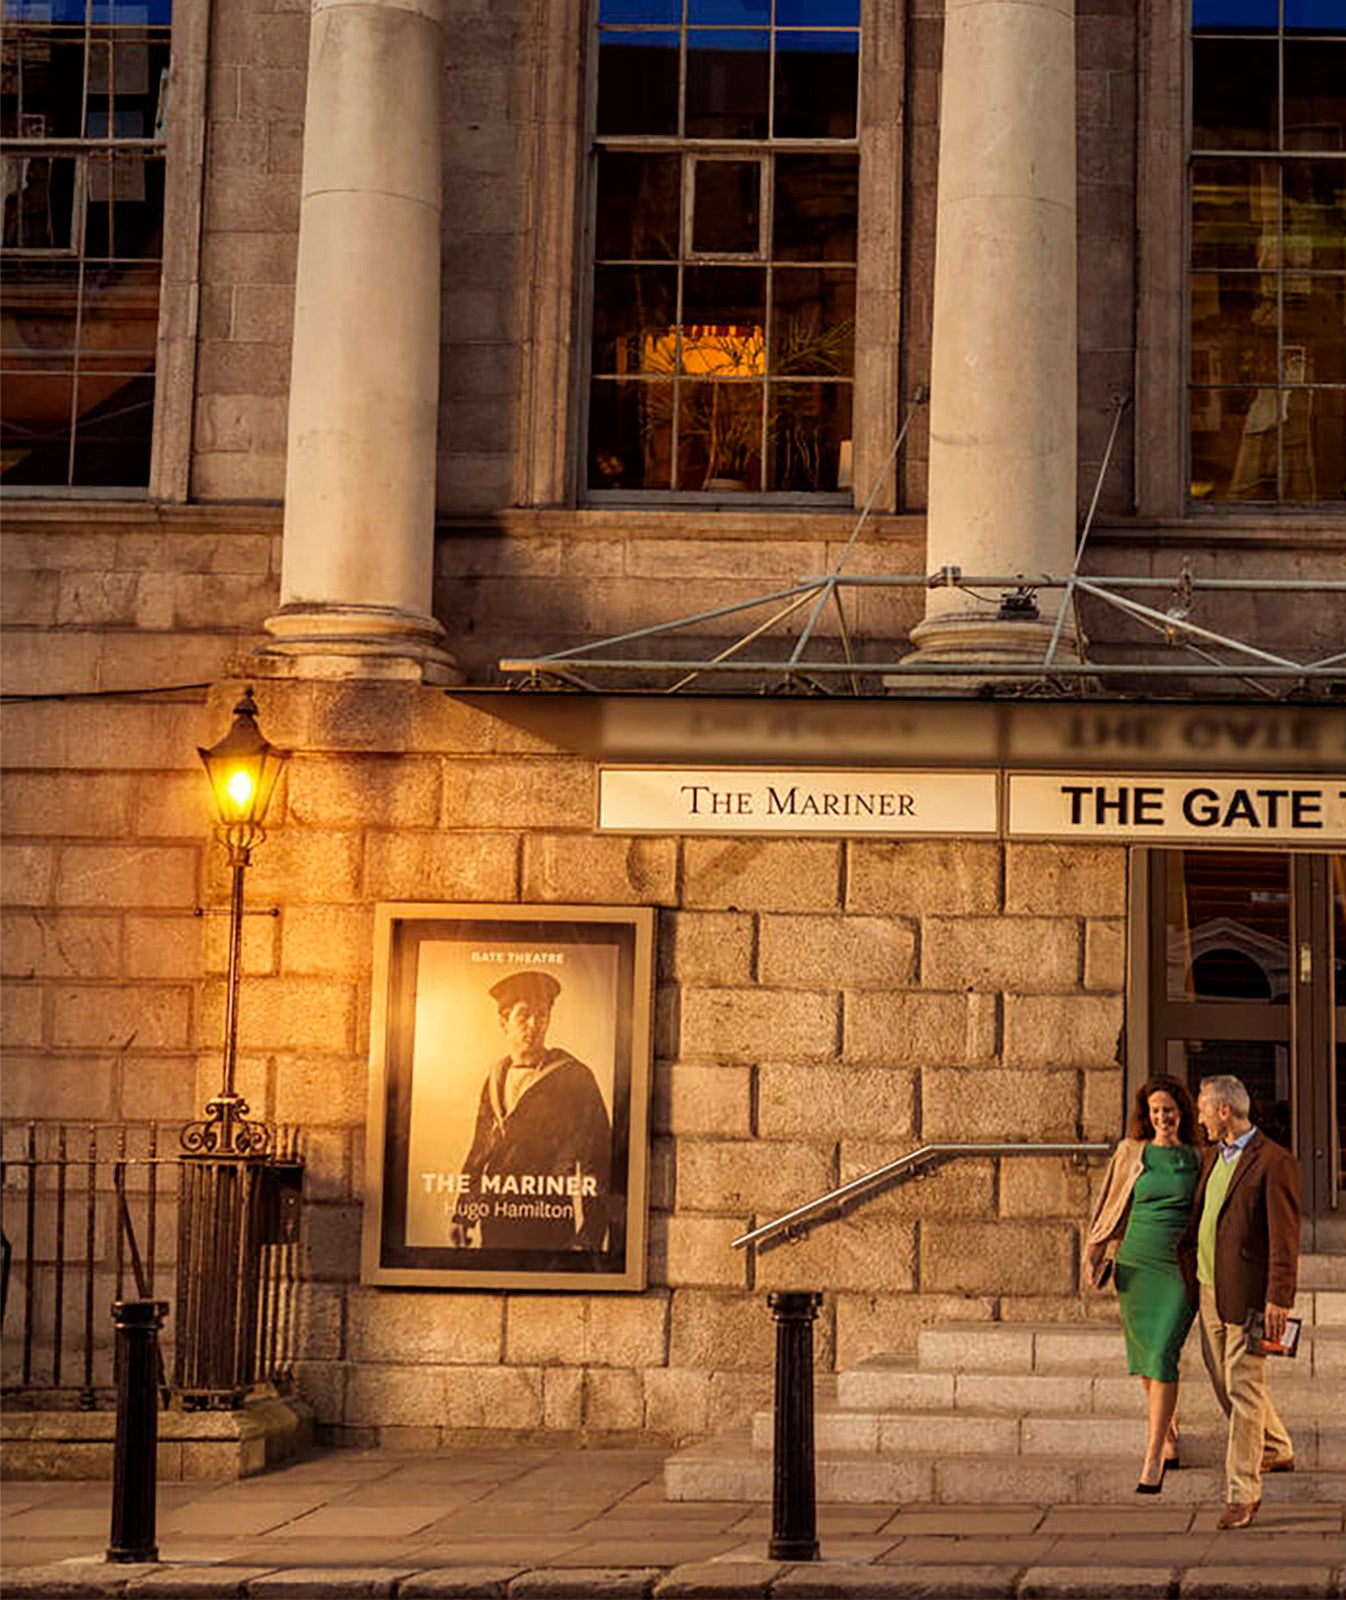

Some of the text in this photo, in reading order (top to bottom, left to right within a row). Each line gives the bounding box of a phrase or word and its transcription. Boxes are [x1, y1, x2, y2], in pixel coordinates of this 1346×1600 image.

[1061, 785, 1164, 825] THE
[1183, 787, 1323, 829] GATE
[471, 951, 564, 965] GATE THEATRE
[421, 1173, 597, 1197] THE MARINER
[444, 1200, 574, 1221] Hugo Hamilton
